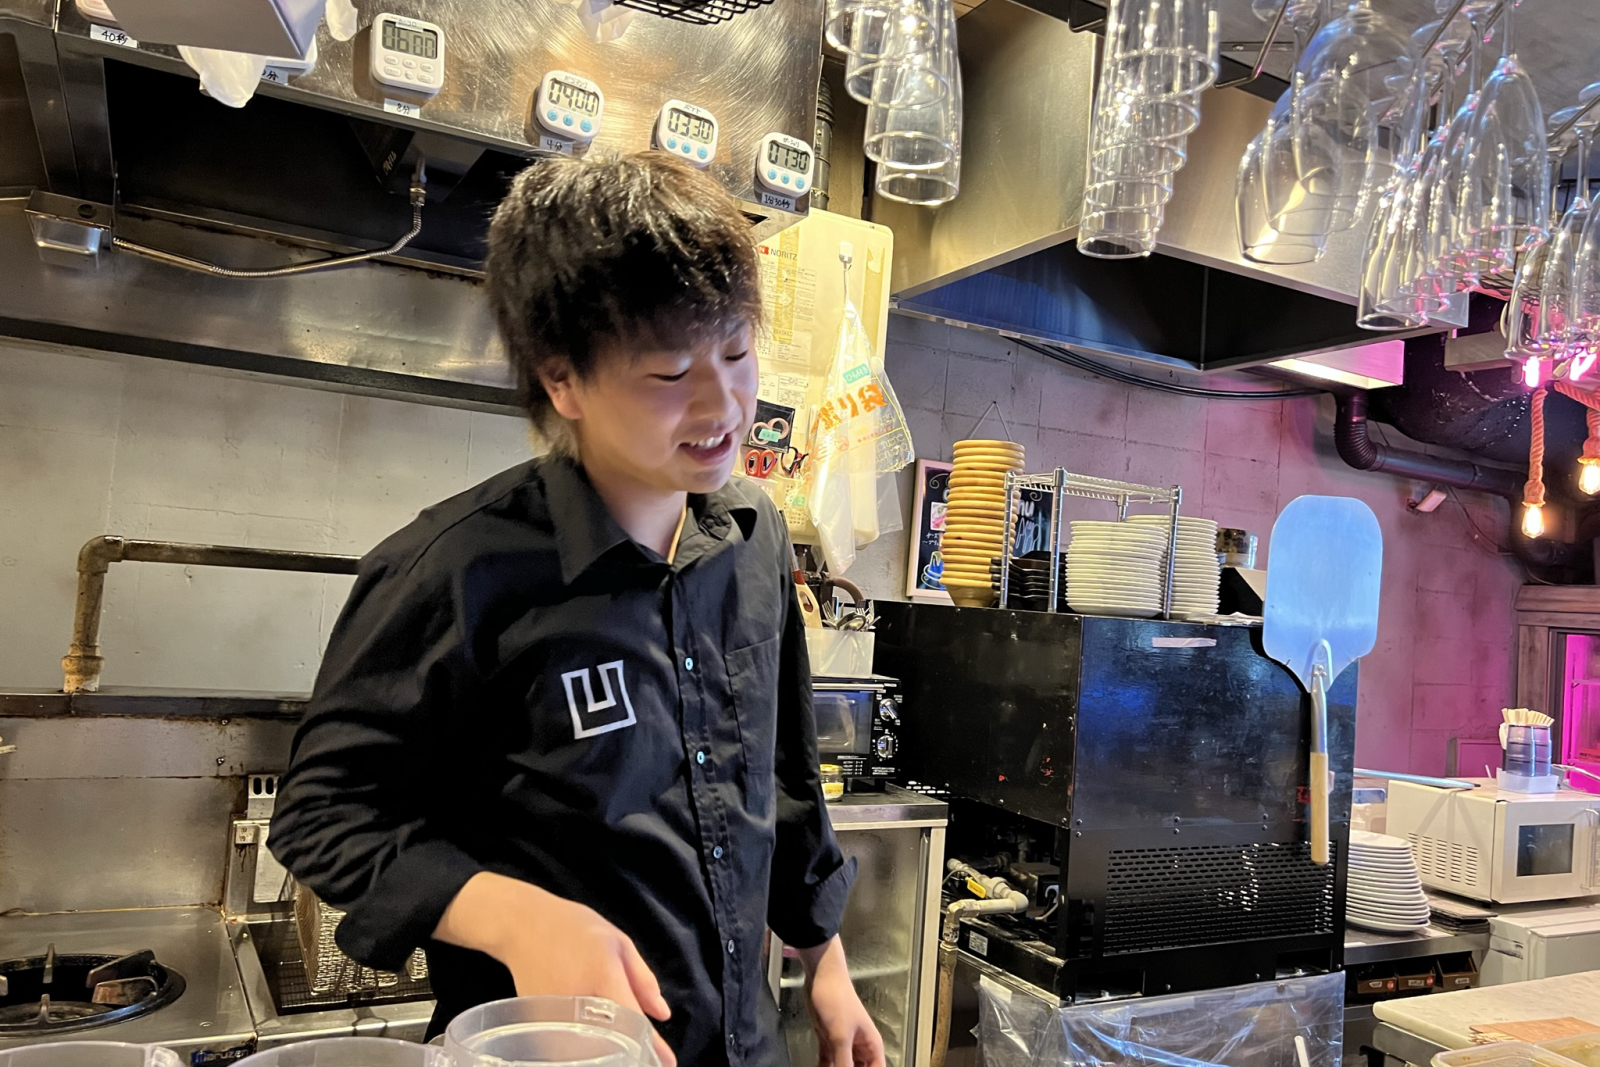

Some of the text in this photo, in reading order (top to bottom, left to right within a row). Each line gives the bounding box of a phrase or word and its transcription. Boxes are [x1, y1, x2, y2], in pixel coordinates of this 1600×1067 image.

[101, 30, 128, 46] 40秒
[547, 139, 563, 151] 4分
[770, 248, 798, 261] NORITZ
